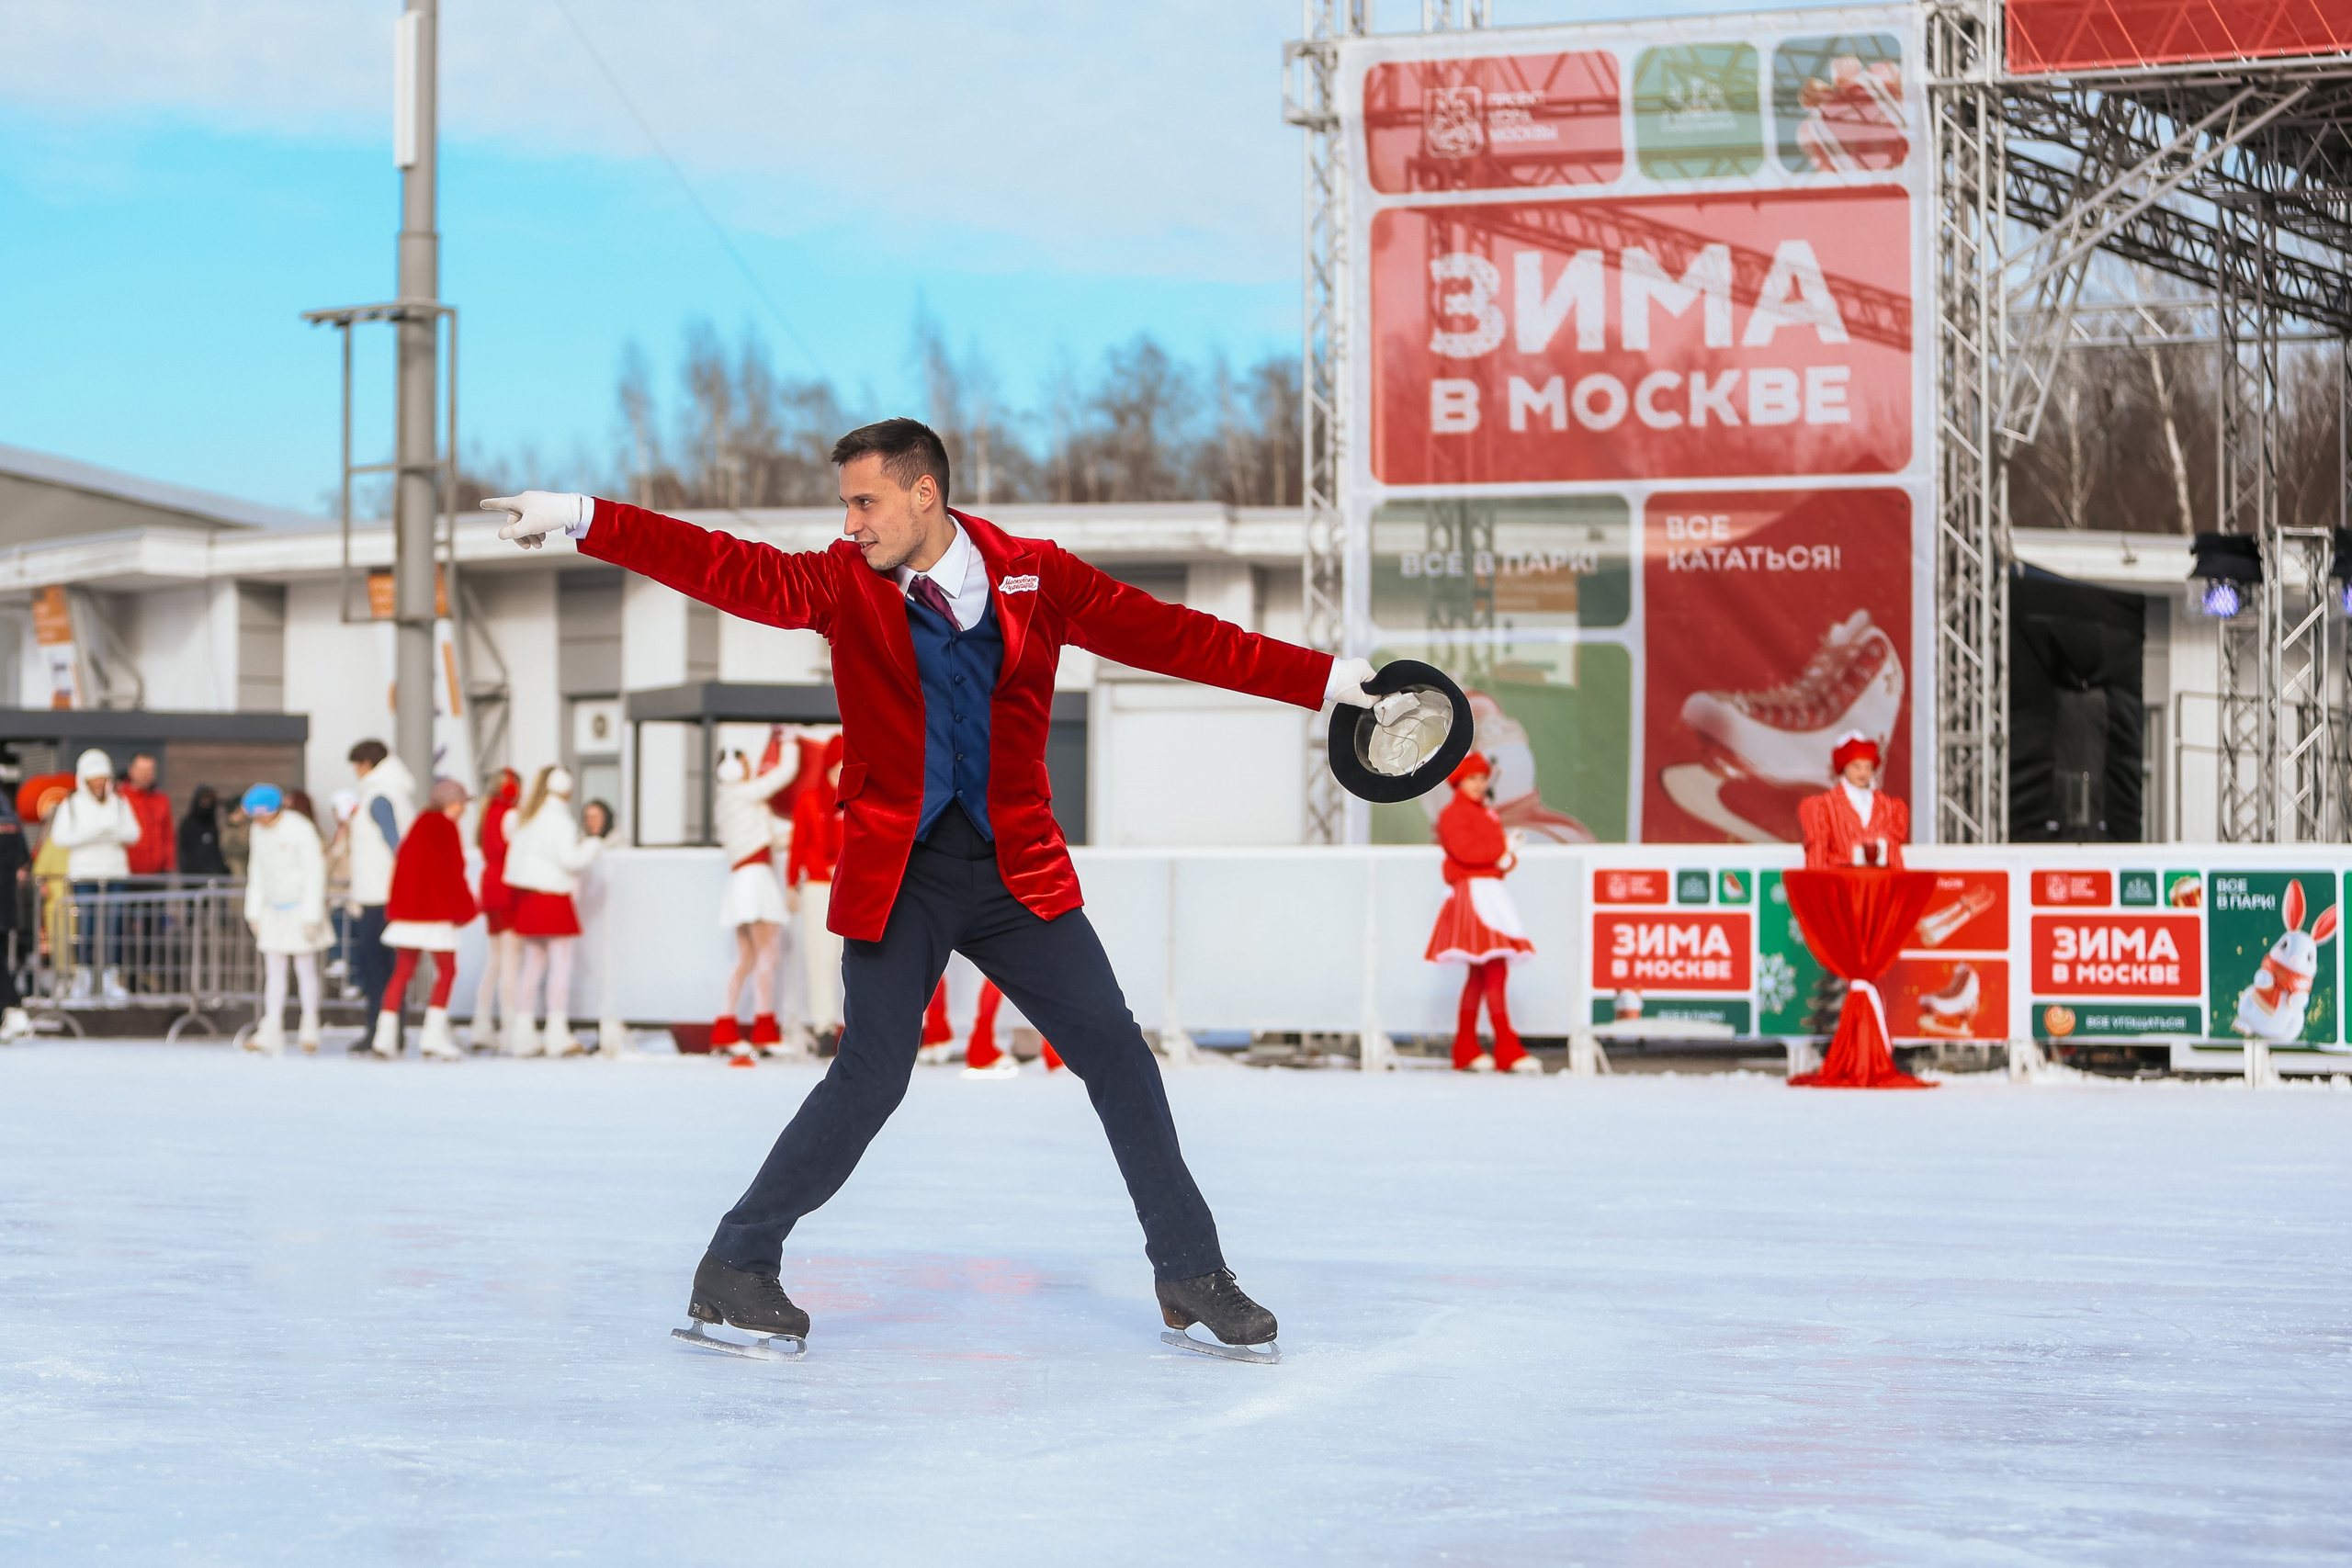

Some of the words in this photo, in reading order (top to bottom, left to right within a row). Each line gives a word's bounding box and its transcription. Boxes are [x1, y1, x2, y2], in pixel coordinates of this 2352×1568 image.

[1430, 240, 1850, 358] ЗИМА
[1431, 378, 1481, 434] В
[1508, 366, 1851, 432] МОСКВЕ
[1667, 515, 1731, 540] ВСЕ
[1401, 553, 1464, 577] ВСЕ
[1474, 551, 1496, 576] В
[1502, 551, 1599, 576] ПАРК!
[1668, 545, 1841, 571] КАТАТЬСЯ!
[2216, 878, 2248, 894] ВСЕ
[2216, 894, 2228, 910] В
[2230, 894, 2276, 910] ПАРК!
[1612, 923, 1732, 956] ЗИМА
[2052, 926, 2180, 962] ЗИМА
[1611, 959, 1628, 979] В
[1634, 959, 1733, 980] МОСКВЕ
[2052, 964, 2069, 984] В
[2076, 964, 2180, 986] МОСКВЕ
[2086, 1015, 2110, 1030] ВСЕ
